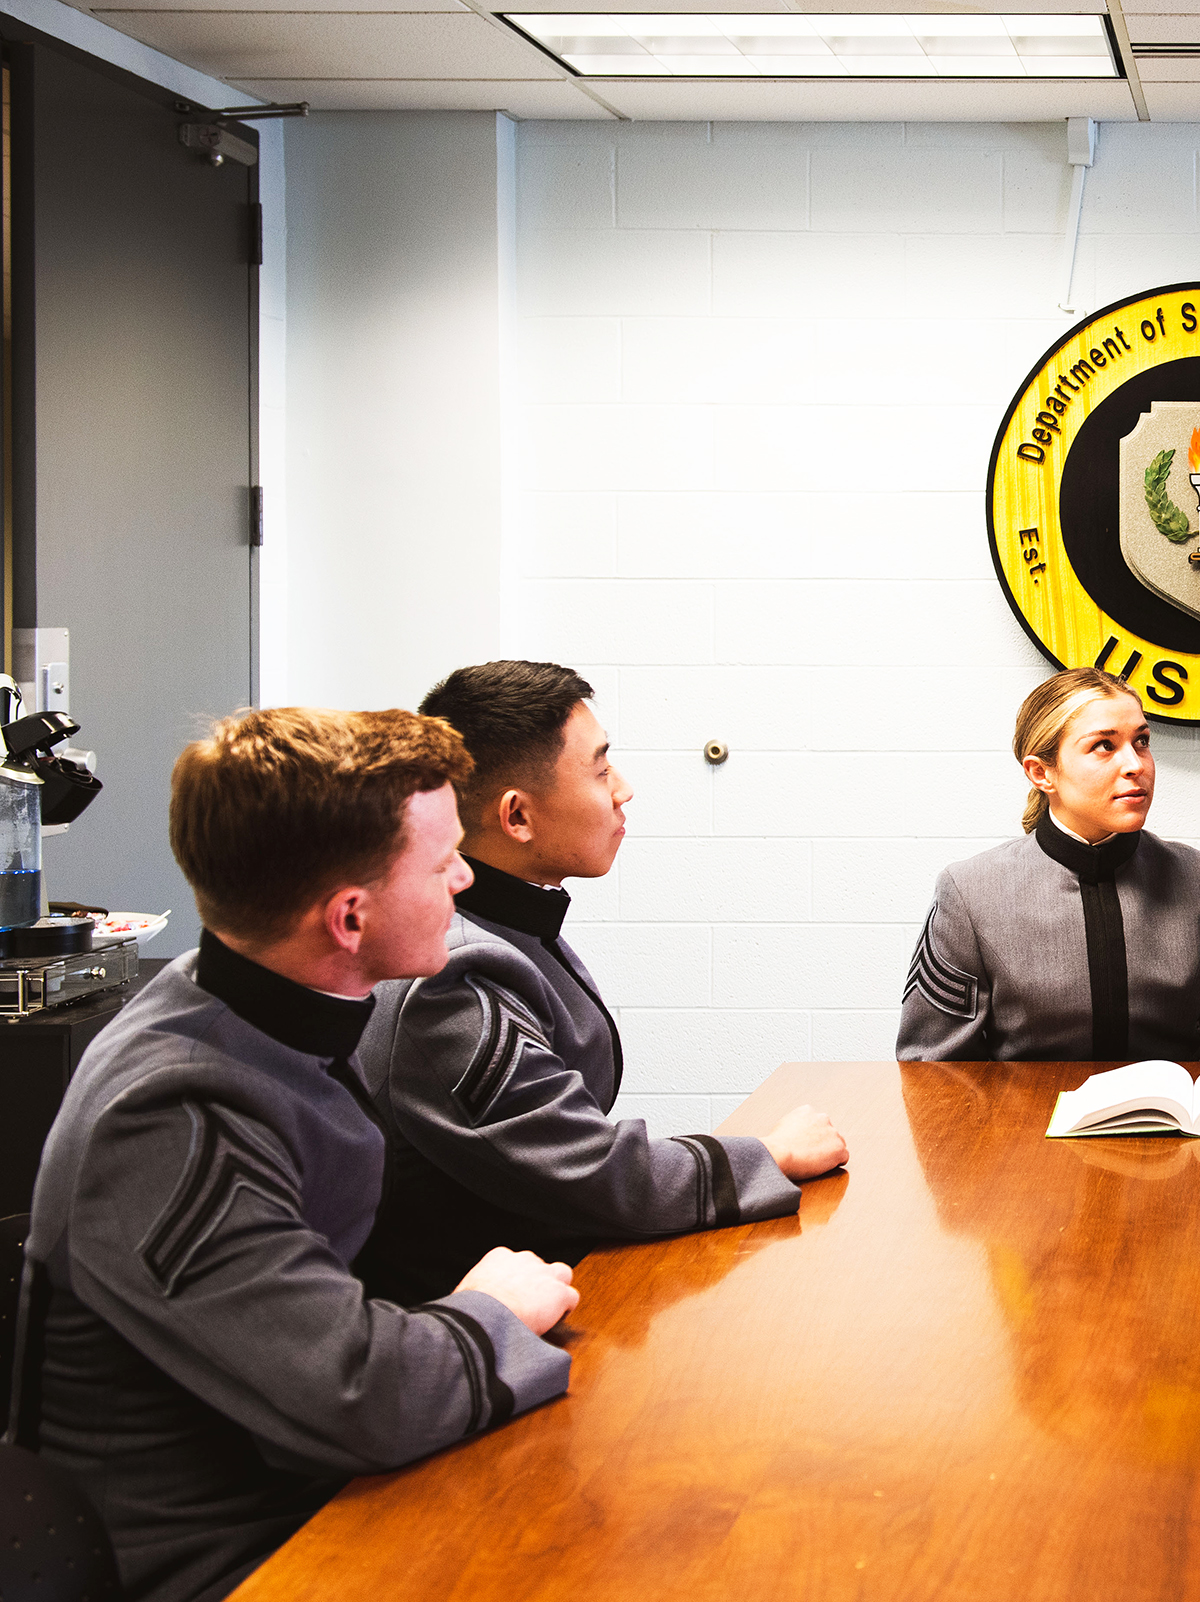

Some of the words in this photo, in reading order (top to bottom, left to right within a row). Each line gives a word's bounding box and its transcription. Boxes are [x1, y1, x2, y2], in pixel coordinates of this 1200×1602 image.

[1017, 325, 1132, 465] Department
[1141, 307, 1166, 342] of
[1018, 526, 1046, 585] Est.
